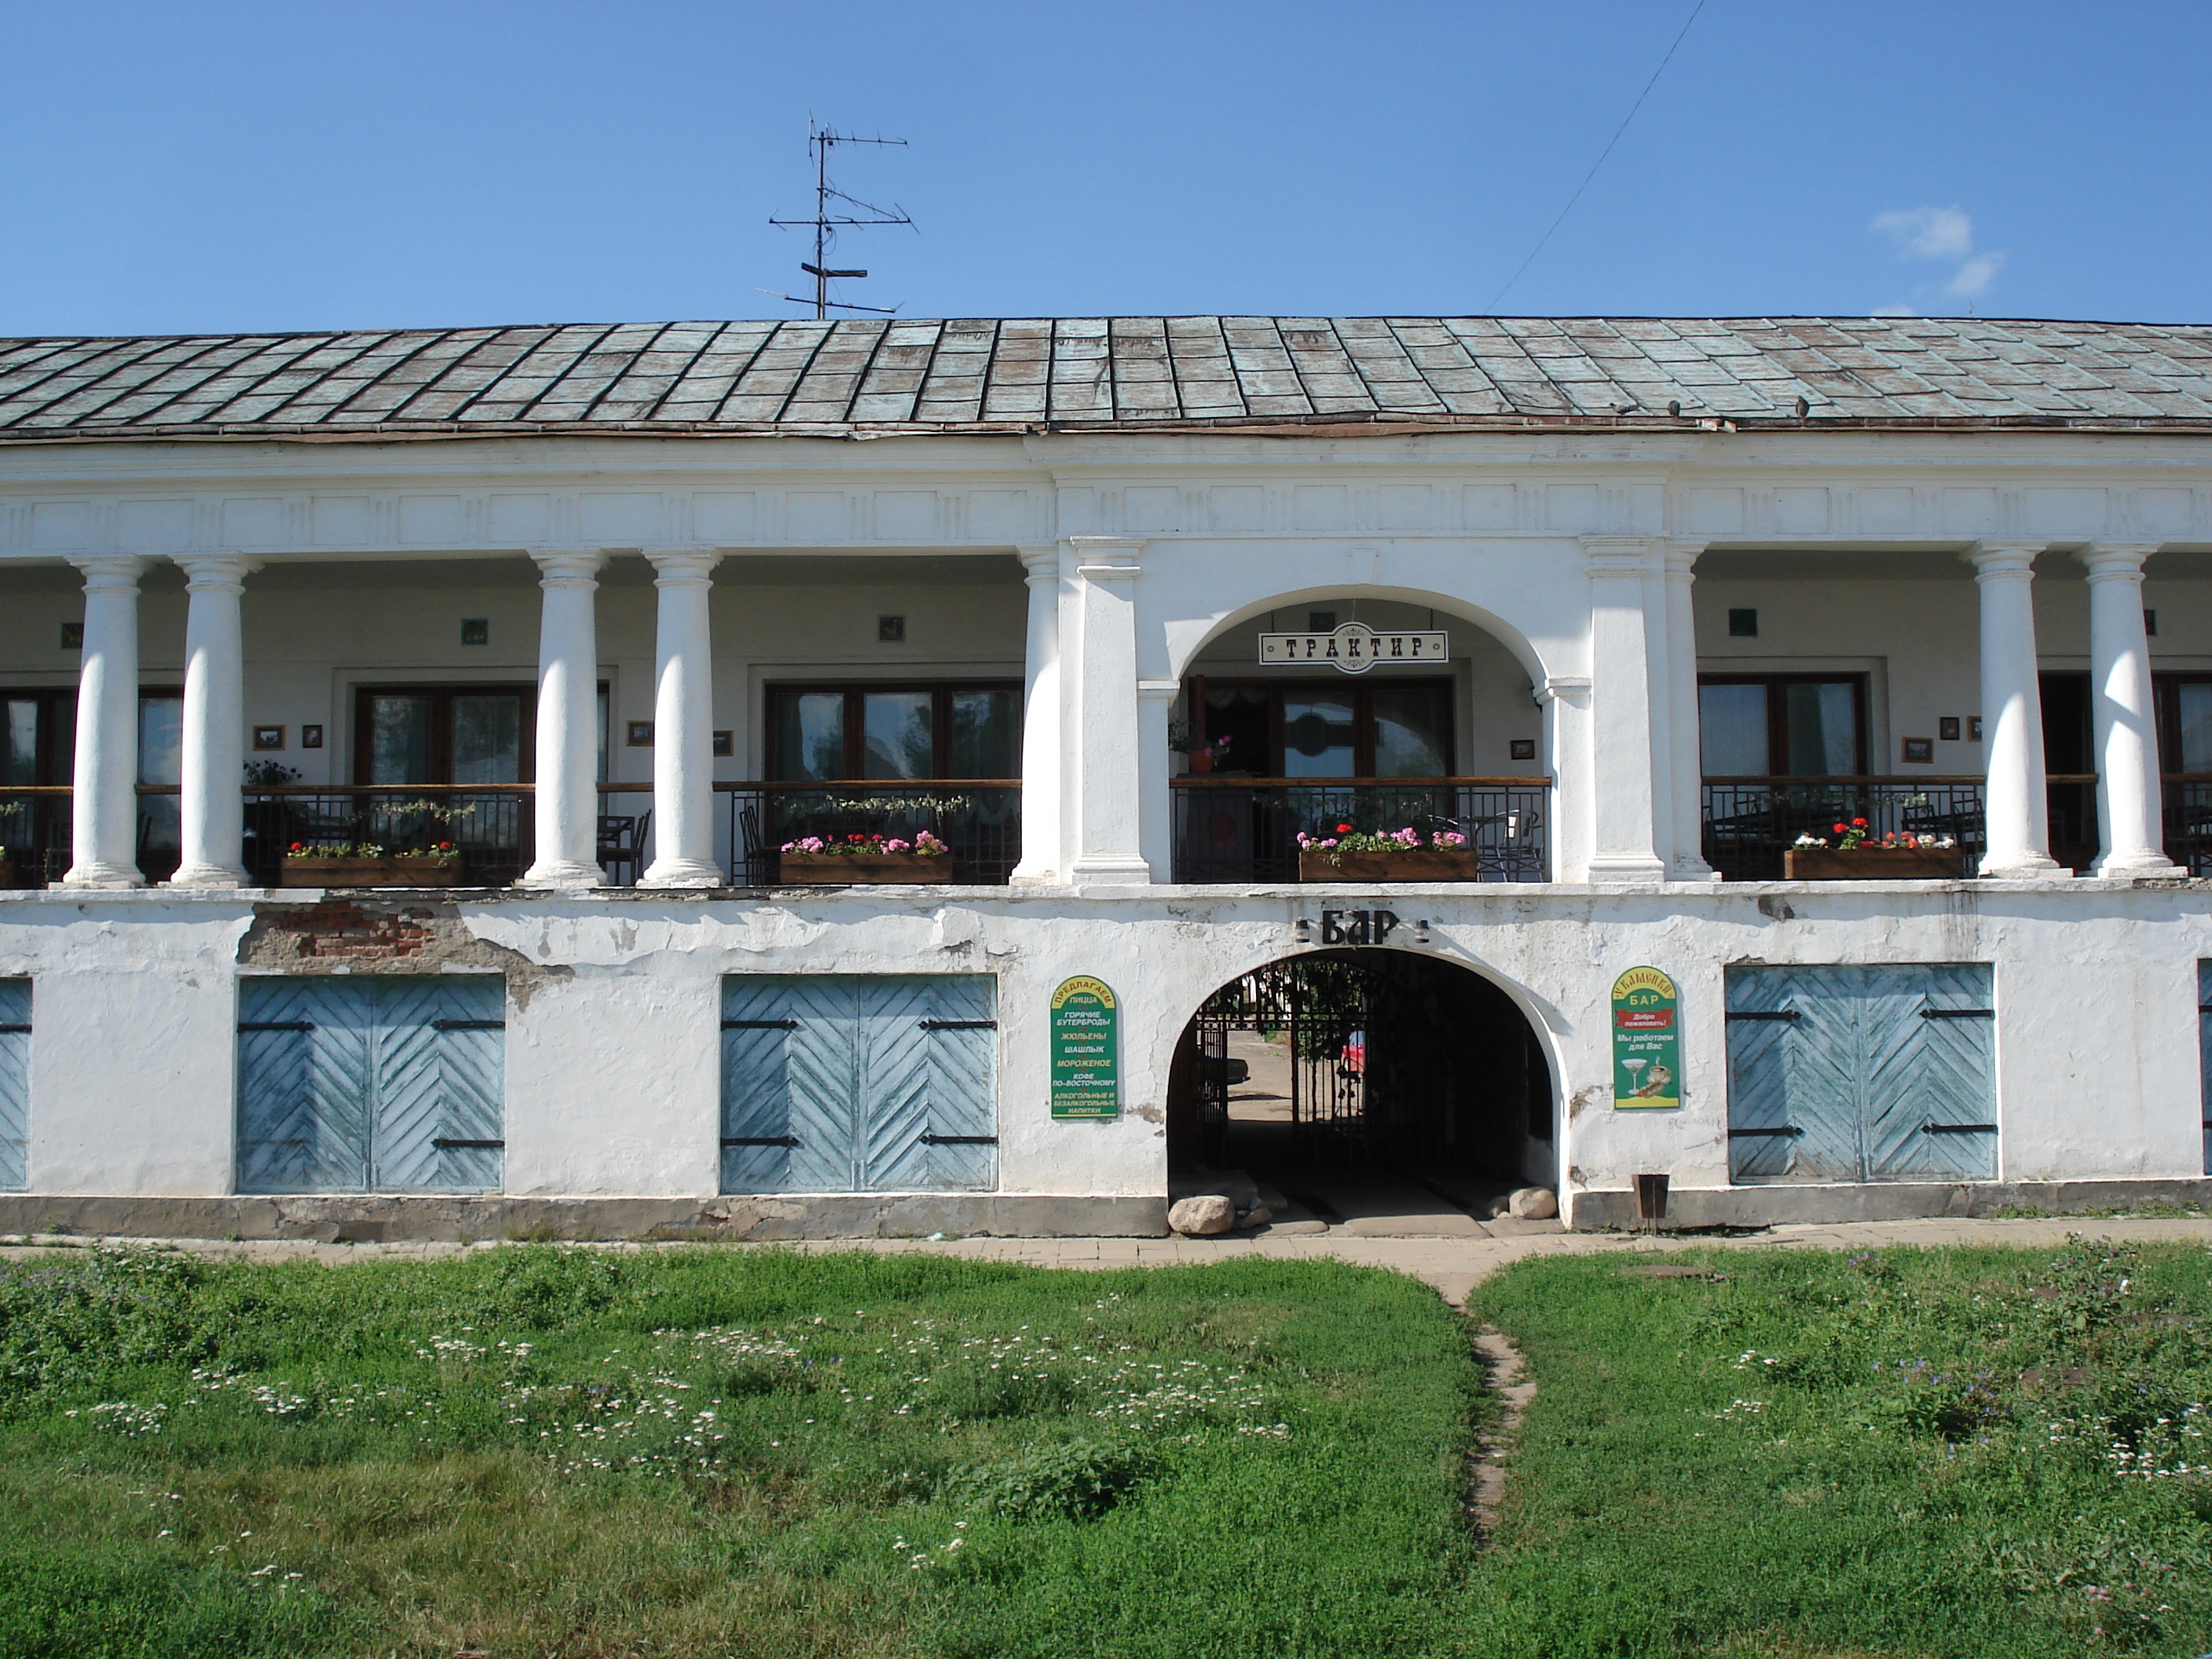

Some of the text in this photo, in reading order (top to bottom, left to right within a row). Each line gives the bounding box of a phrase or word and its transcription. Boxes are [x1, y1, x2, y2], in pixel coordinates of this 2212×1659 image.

[1286, 637, 1423, 658] ТРАКТИР
[1322, 910, 1401, 945] БАР
[1054, 981, 1111, 1004] ПРЕДЛАГАЕМ
[1069, 996, 1097, 1005] ПИЦЦА
[1629, 994, 1659, 1005] БАР
[1056, 1018, 1111, 1027] БУТЕРБРОДЫ
[1617, 1034, 1674, 1043] Мы работаем
[1628, 1043, 1645, 1052] для
